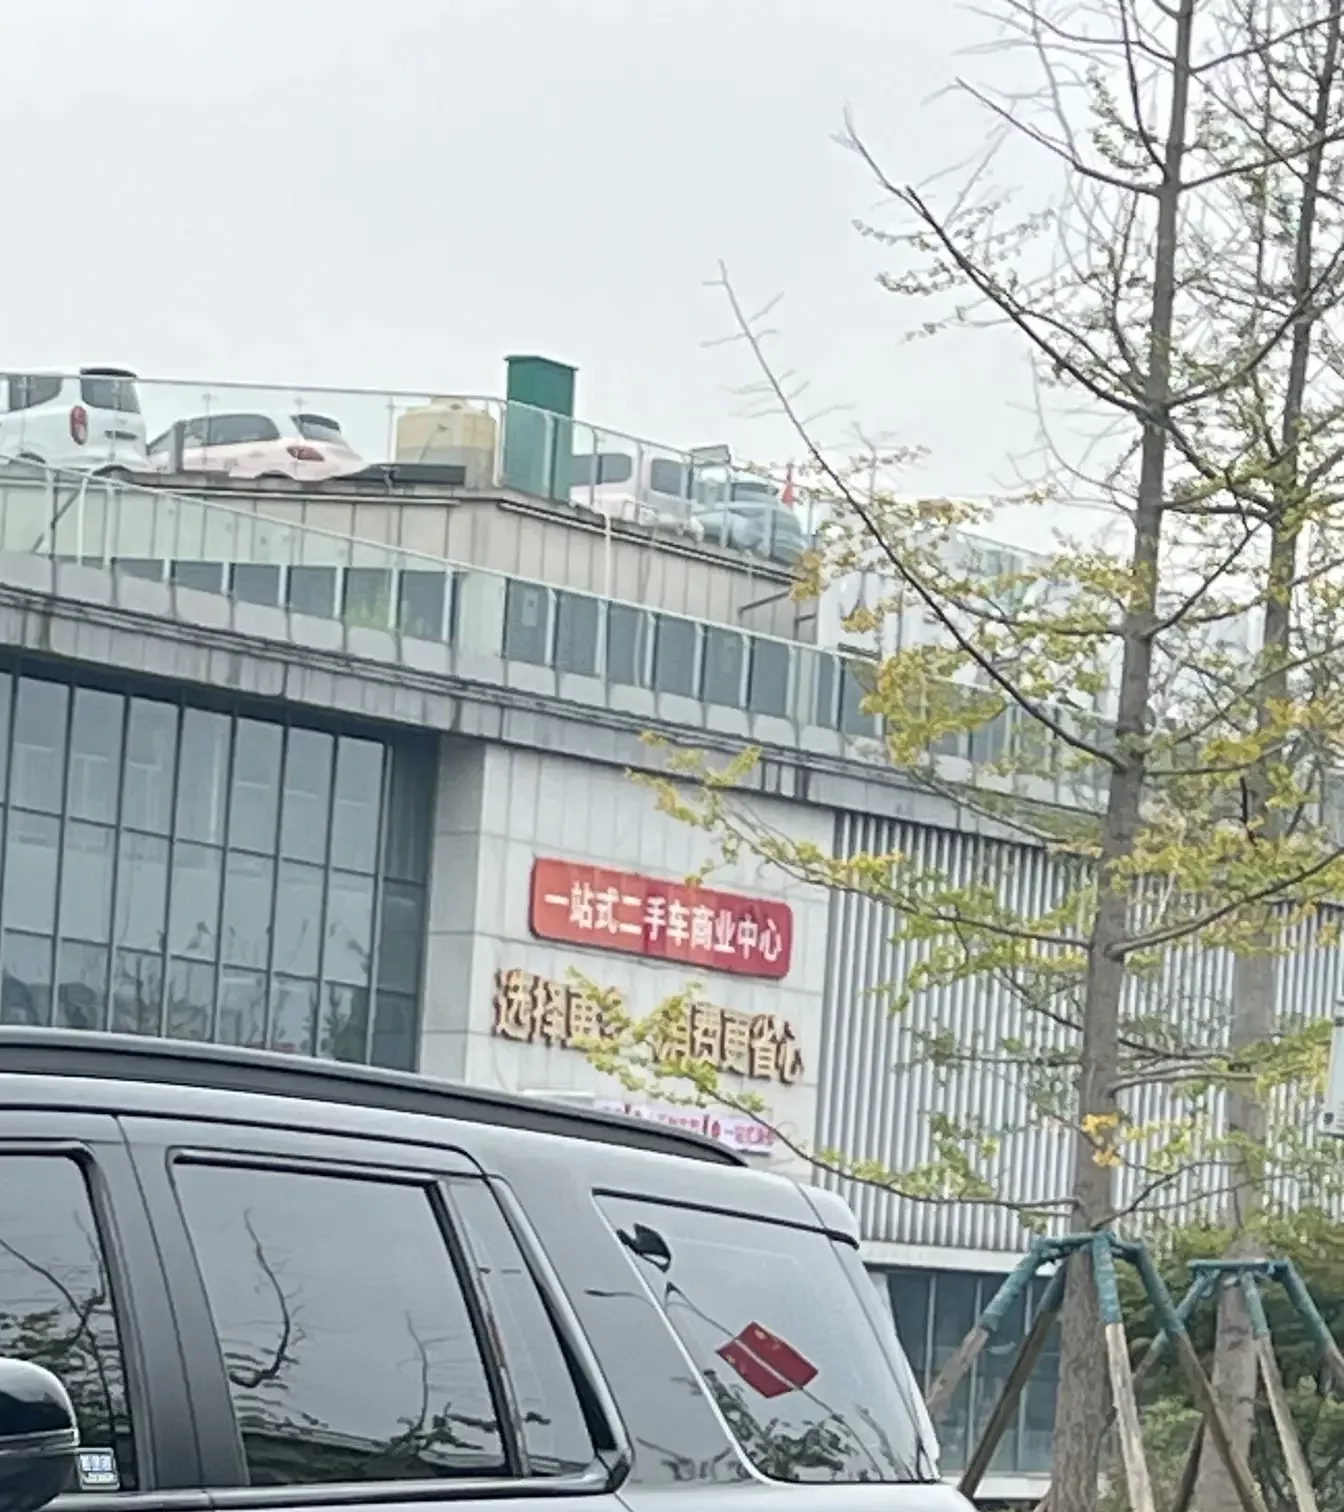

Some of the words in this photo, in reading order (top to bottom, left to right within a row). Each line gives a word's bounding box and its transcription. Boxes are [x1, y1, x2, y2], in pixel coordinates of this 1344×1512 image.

[544, 881, 782, 961] 一站式二手车商业中心
